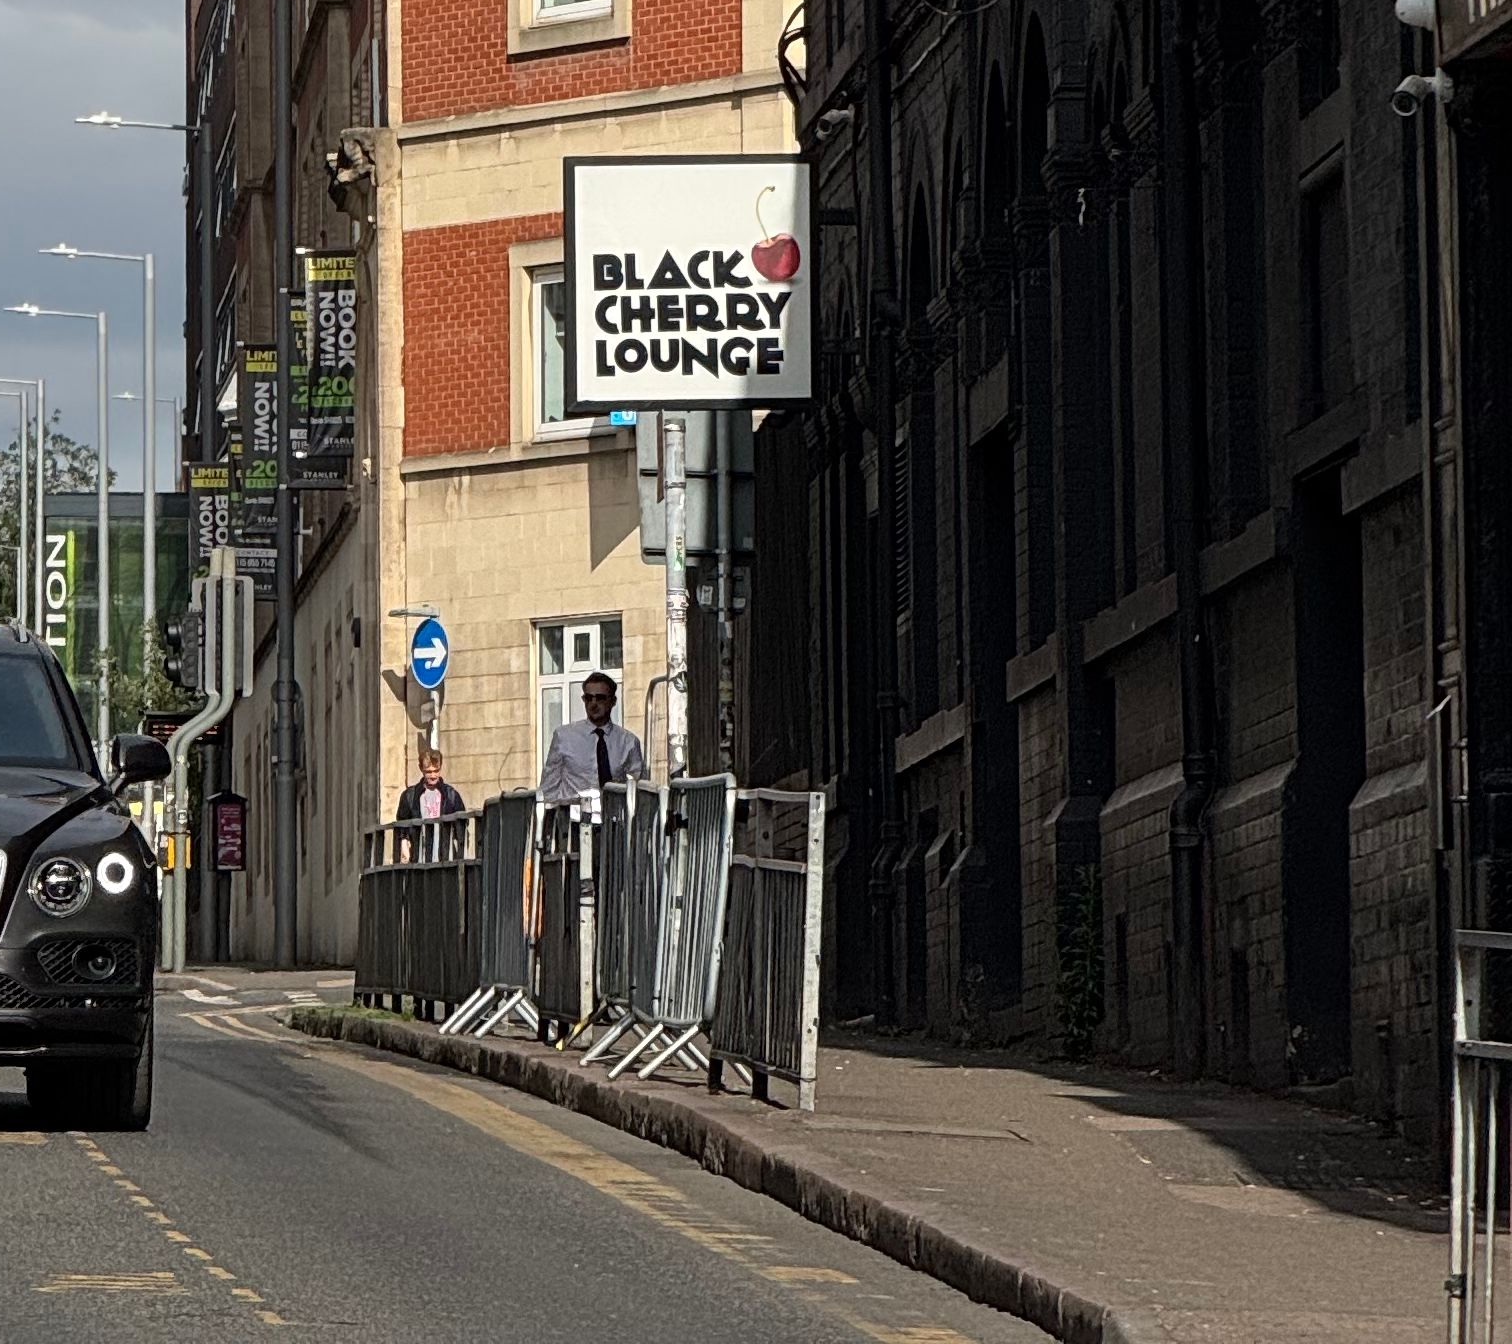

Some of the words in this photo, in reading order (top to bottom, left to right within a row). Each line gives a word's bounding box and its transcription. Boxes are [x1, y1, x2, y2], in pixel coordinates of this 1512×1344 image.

[593, 249, 753, 291] BLACK
[319, 292, 336, 367] NOW!!
[337, 289, 356, 369] BOOK
[595, 292, 792, 334] CHERRY
[595, 337, 784, 379] LOUNGE
[253, 382, 270, 451] NOW!!
[214, 495, 229, 549] BOO
